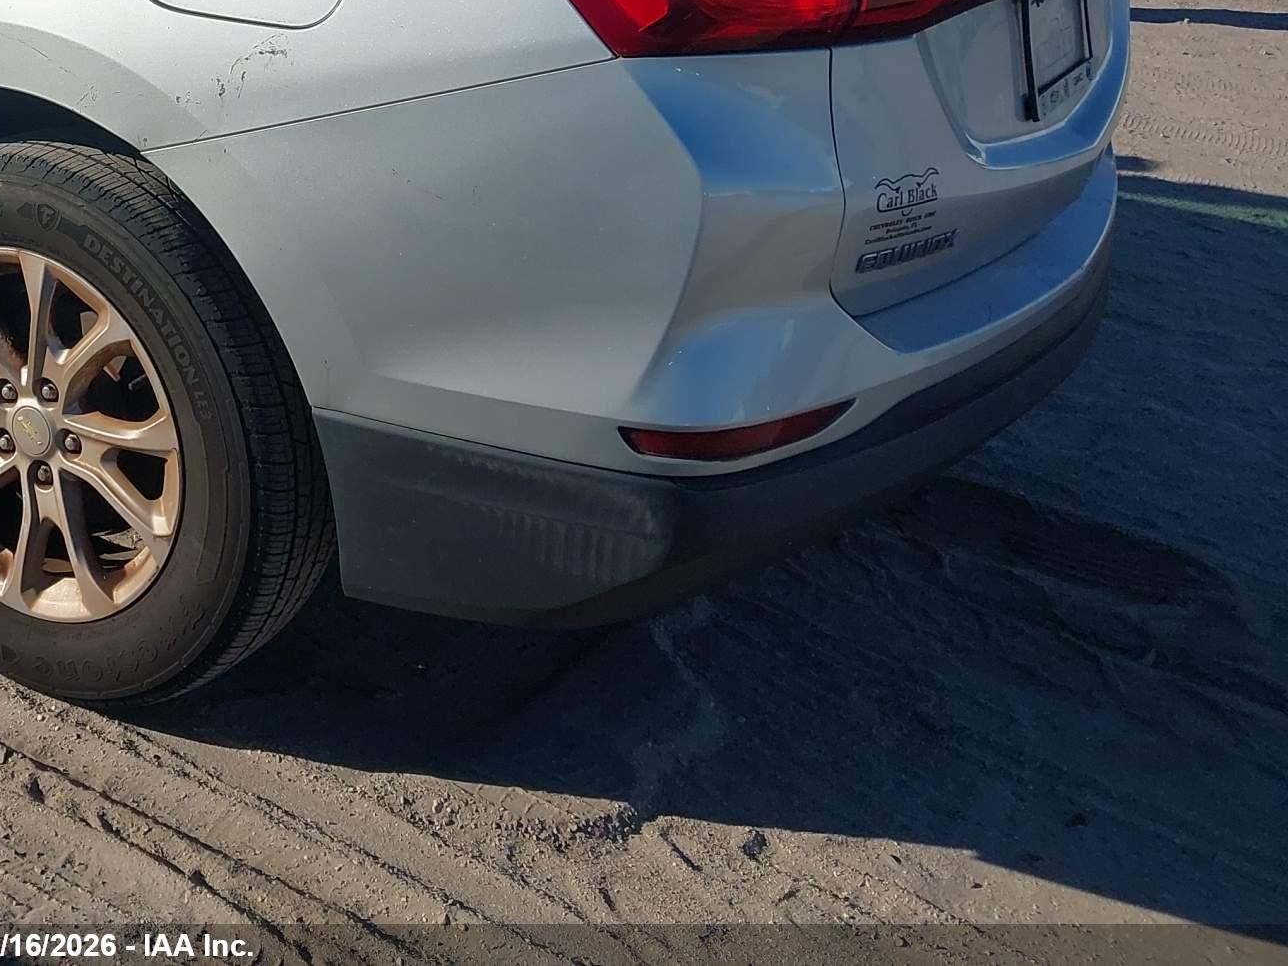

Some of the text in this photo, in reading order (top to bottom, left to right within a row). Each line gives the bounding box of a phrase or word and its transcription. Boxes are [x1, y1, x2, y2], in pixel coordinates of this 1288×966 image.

[876, 183, 938, 213] Carl Black
[855, 228, 960, 274] EQUINOX
[83, 231, 201, 386] DESTINATION
